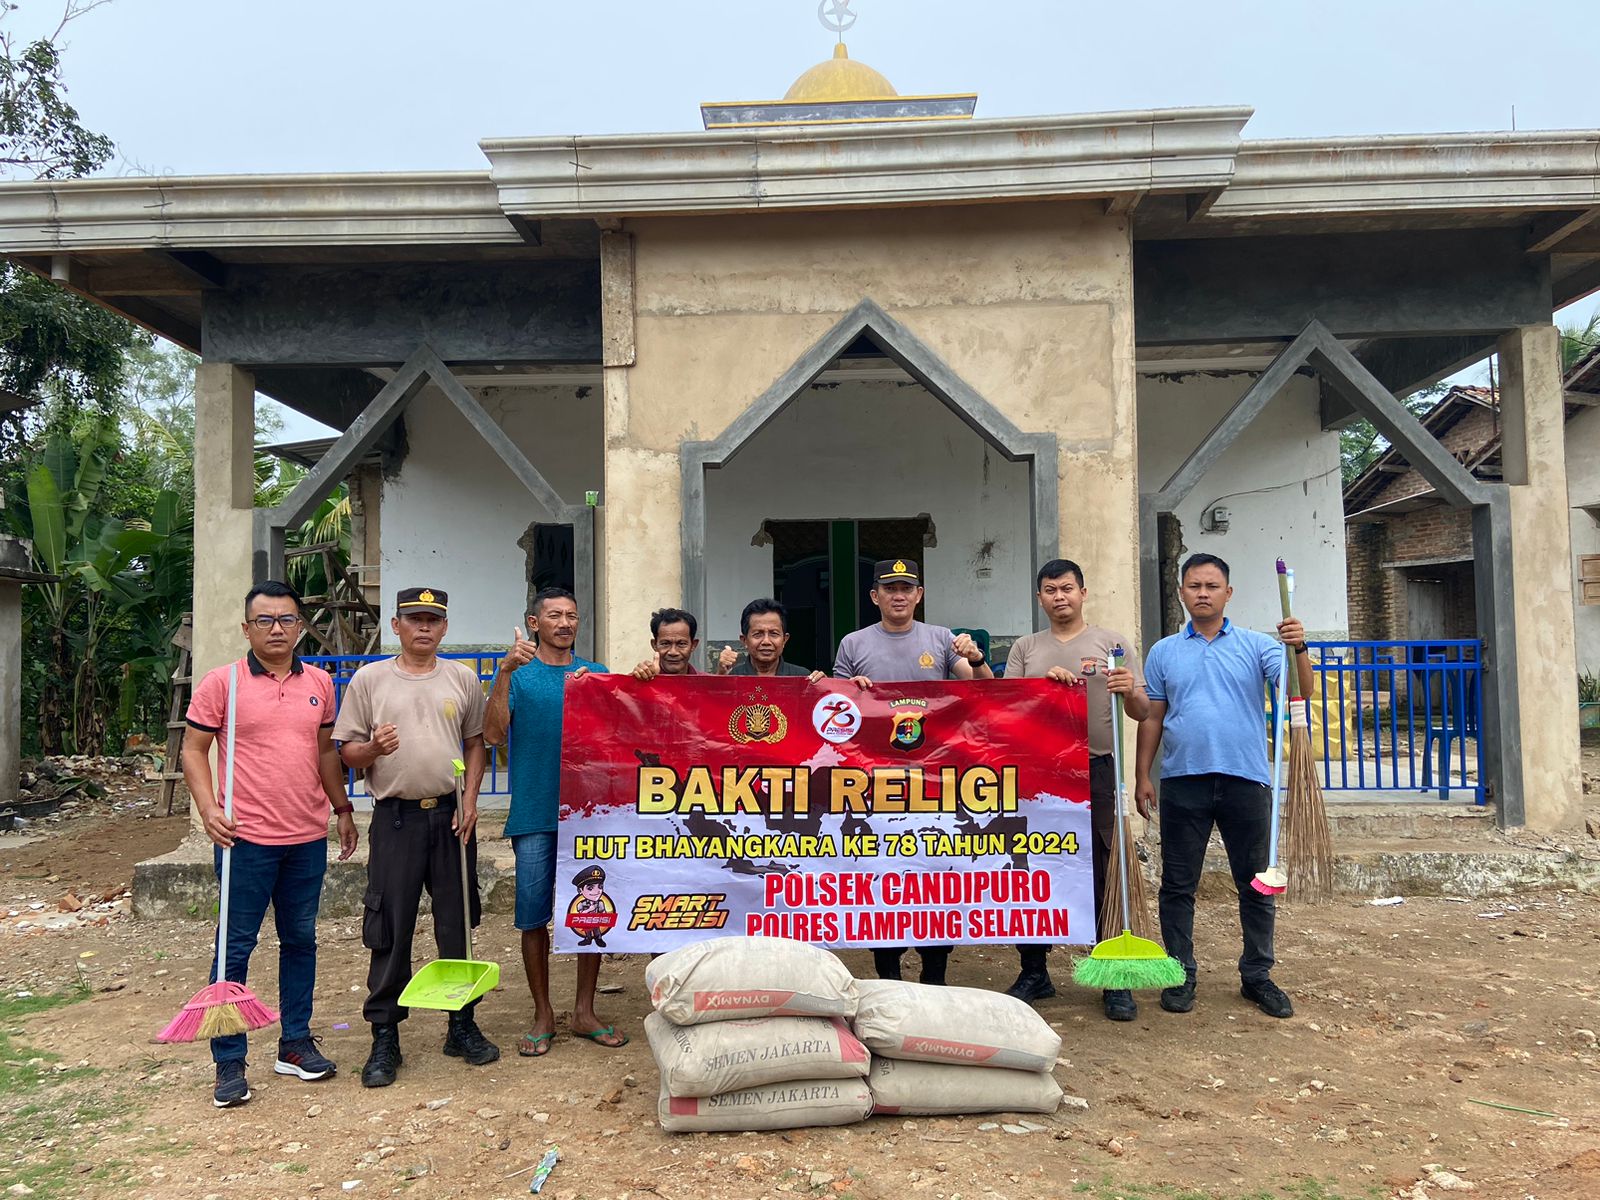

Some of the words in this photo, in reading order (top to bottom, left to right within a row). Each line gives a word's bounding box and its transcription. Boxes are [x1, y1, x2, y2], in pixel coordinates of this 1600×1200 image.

[890, 698, 928, 708] LAMPUNG
[637, 766, 811, 814] BAKTI
[828, 765, 1019, 813] RELIGI
[575, 836, 629, 859] HUT
[635, 833, 836, 859] BHAYANGKARA
[842, 833, 880, 857] KE
[885, 833, 917, 857] 78
[922, 832, 1010, 856] TAHUN
[1012, 831, 1079, 855] 2024
[764, 872, 875, 907] POLSEK
[881, 869, 1051, 905] CANDIPURO
[633, 894, 726, 912] SMART
[571, 916, 612, 925] PRESISI
[629, 911, 729, 930] PRESISI
[746, 912, 839, 942] POLRES
[845, 909, 962, 941] LAMPUNG
[969, 908, 1069, 938] SELATAN
[707, 994, 770, 1008] DYNAMIX
[704, 1049, 757, 1072] SEMEN
[760, 1040, 832, 1061] JAKARTA
[915, 1042, 976, 1058] DYNAMIX
[708, 1091, 765, 1108] SEMEN
[768, 1086, 840, 1104] JAKARTA
